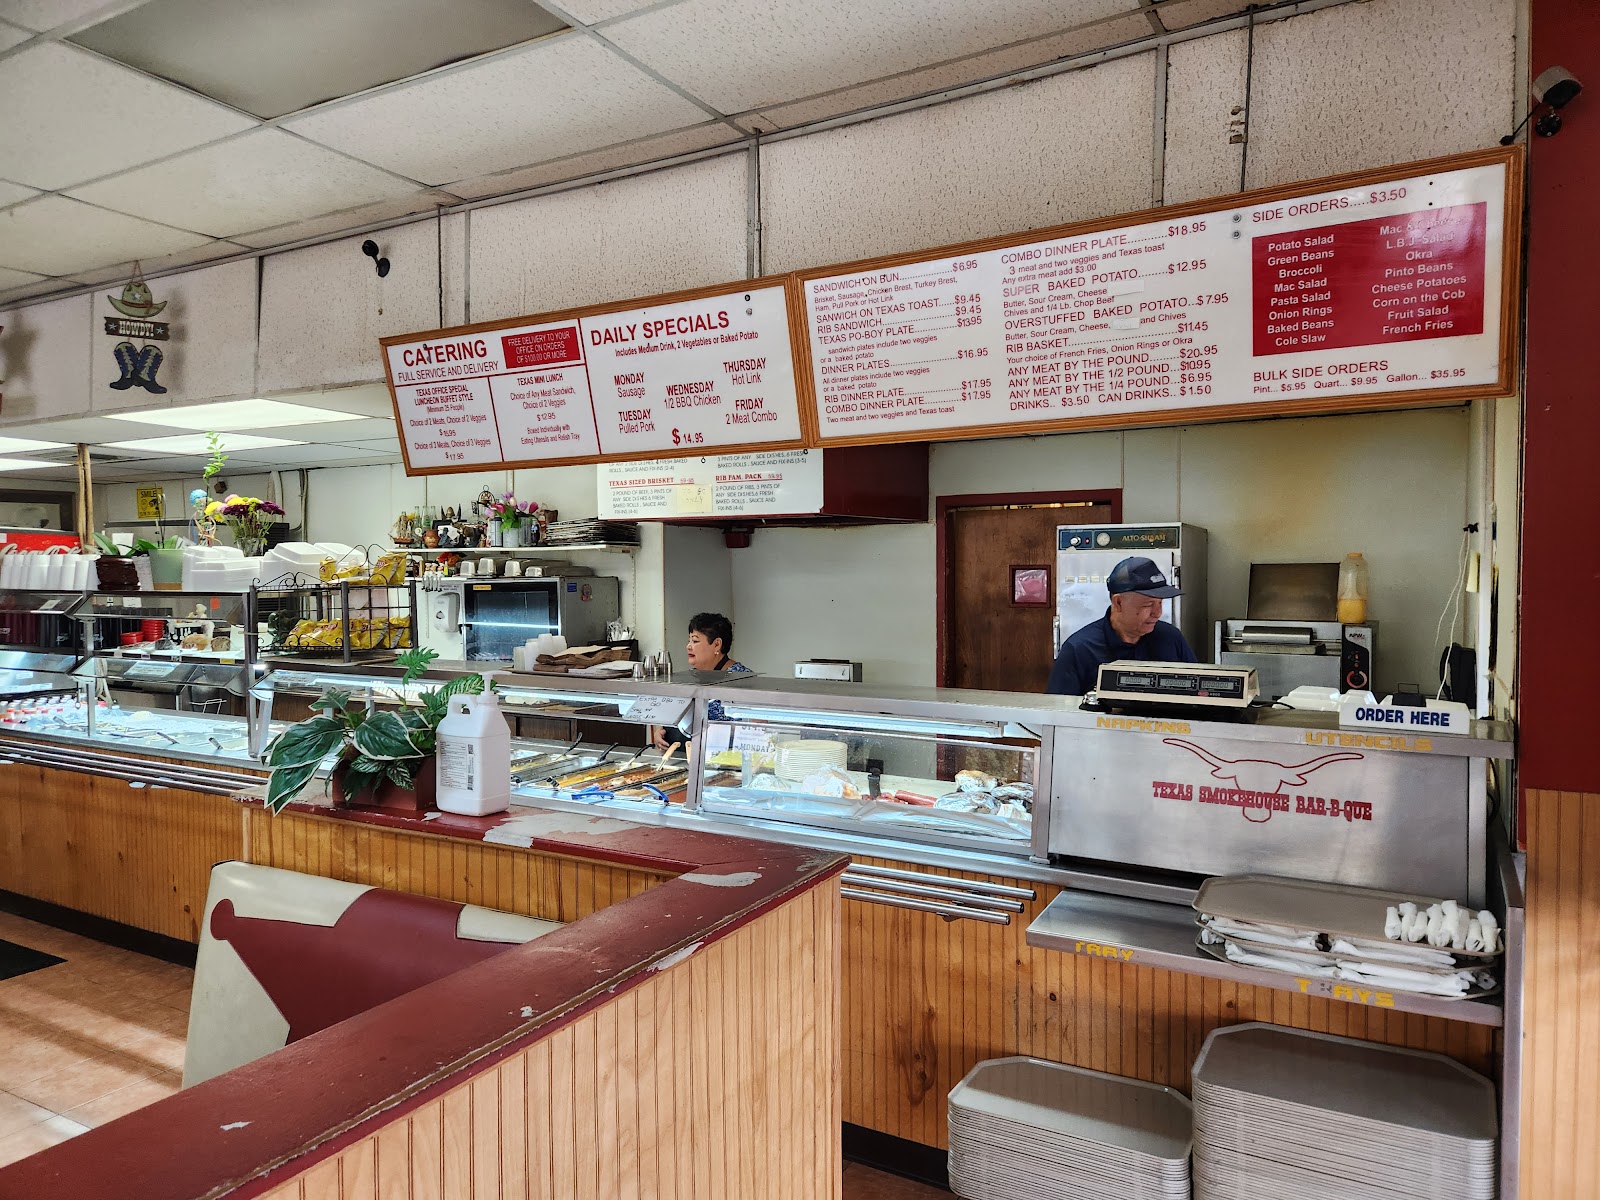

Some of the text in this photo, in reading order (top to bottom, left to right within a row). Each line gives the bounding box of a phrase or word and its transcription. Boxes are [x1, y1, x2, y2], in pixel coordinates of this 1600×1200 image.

[1252, 188, 1407, 223] SIDE ORDERS $3.50
[1379, 225, 1402, 236] Mac
[1422, 232, 1454, 244] Salad
[1001, 249, 1042, 264] COMBO
[1045, 242, 1088, 257] DINNER
[1168, 221, 1206, 237] $18.95
[1268, 234, 1334, 252] Potato Salad
[1267, 250, 1335, 266] Green Beans
[1405, 251, 1433, 261] Okra
[1279, 265, 1322, 279] Broccoli
[1385, 262, 1453, 278] Pinto Beans
[814, 279, 861, 294] SANDWICH
[864, 275, 877, 285] ON
[1002, 284, 1039, 298] SUPER
[1048, 277, 1086, 291] BAKED
[1274, 278, 1327, 293] Mac Salad
[1371, 275, 1467, 294] Cheese Potatoes
[1270, 291, 1331, 307] Pasta Salad
[1372, 290, 1466, 308] Corn on the Cob
[816, 310, 857, 323] SANWICH
[860, 307, 873, 316] ON
[876, 302, 906, 314] TEXAS
[954, 294, 981, 305] $9.45
[1269, 306, 1333, 321] Onion Rings
[1388, 305, 1449, 320] Fruit Salad
[818, 325, 832, 334] RIB
[955, 305, 982, 316] $9.45
[1005, 312, 1085, 330] OVERSTUFFED
[1093, 305, 1133, 319] BAKED
[119, 321, 154, 337] HOWDY!
[591, 311, 729, 346] DAILY SPECIALS
[1267, 319, 1335, 334] Baked Beans
[1383, 320, 1453, 335] French Fries
[508, 331, 570, 346] FREE DELIVERY TO YOUR
[615, 348, 637, 357] Includes
[638, 344, 659, 354] Medium
[660, 343, 676, 352] Drink,
[682, 336, 711, 349] Vegetables
[721, 334, 738, 343] Baked
[740, 331, 758, 340] Potato
[818, 333, 847, 344] TEXAS
[849, 328, 883, 340] PO-BOY
[1275, 333, 1326, 347] Cole Slaw
[403, 339, 487, 366] CATERING
[516, 345, 534, 354] OFFICE
[543, 343, 565, 352] ORDERS
[1006, 344, 1024, 353] RIB
[723, 357, 766, 373] THURSDAY
[1008, 367, 1029, 377] ANY
[1032, 363, 1061, 373] MEAT
[1064, 362, 1078, 371] BY
[1081, 359, 1104, 368] THE
[1179, 345, 1218, 359] $20.95
[398, 361, 499, 382] FULL SERVICE AND DELIVERY
[518, 376, 533, 385] TEXAS
[546, 373, 563, 382] LUNCH
[614, 372, 645, 386] MONDAY
[732, 372, 762, 386] Hot Link
[1253, 361, 1388, 382] BULK SIDE ORDERS
[666, 381, 714, 396] WEDNESDAY
[1280, 382, 1306, 392] $5.95
[1351, 377, 1378, 386] $9.95
[1430, 369, 1466, 380] $35.95
[617, 386, 646, 398] Sausage
[1061, 395, 1090, 407] $3.50
[1098, 392, 1122, 403] CAN
[664, 394, 721, 409] 1/2 BBQ Chicken
[735, 397, 764, 410] FRIDAY
[618, 409, 651, 422] TUESDAY
[726, 410, 777, 424] 2 Meat Combo
[619, 421, 655, 433] Pulled Pork
[672, 428, 704, 446] $ 14.95
[1356, 708, 1450, 726] ORDER HERE
[1097, 717, 1191, 734] NAPKINS
[1306, 732, 1432, 751] UTENCILS
[1153, 781, 1372, 822] TEXAS SMOKEHOUSE BAR-B-QUE
